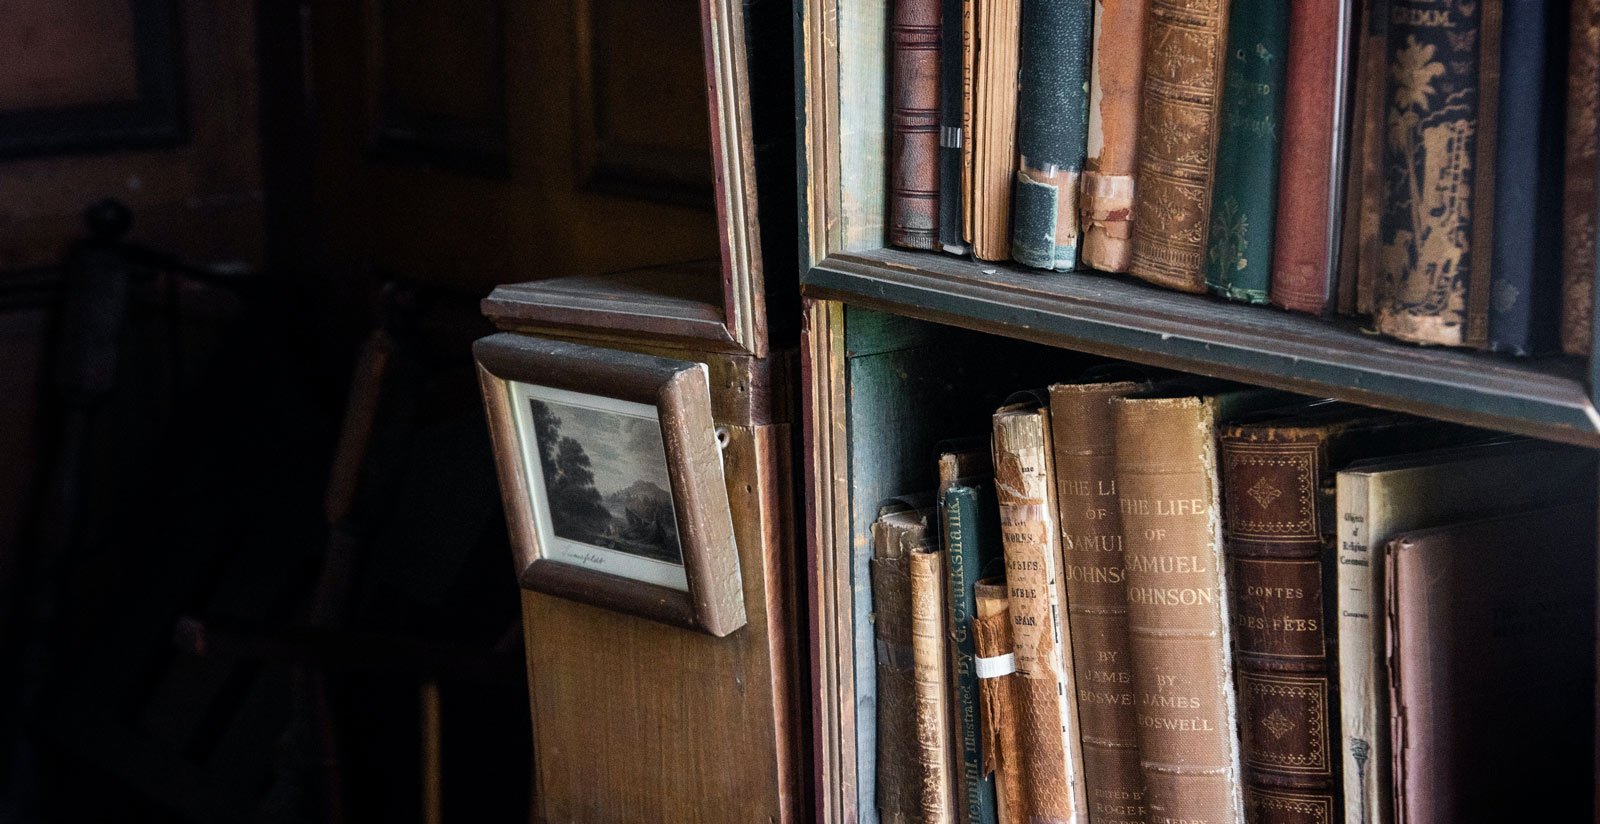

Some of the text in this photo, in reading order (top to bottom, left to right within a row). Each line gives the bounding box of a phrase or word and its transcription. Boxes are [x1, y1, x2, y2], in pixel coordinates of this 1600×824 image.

[1061, 480, 1090, 496] THE
[1086, 508, 1107, 520] OF
[1120, 498, 1206, 516] THE LIFE
[1066, 534, 1123, 552] SAMU
[1144, 529, 1167, 541] OF
[1125, 553, 1207, 574] SAMUEL
[1067, 564, 1126, 584] JOHNS
[1011, 588, 1037, 599] BIBLE
[1247, 586, 1305, 599] CONTES
[1239, 614, 1265, 630] DES
[1099, 651, 1118, 662] BY
[1085, 670, 1130, 683] JAME
[1157, 674, 1177, 686] BY
[1080, 690, 1136, 706] BOSWE
[1143, 693, 1201, 709] JAMES
